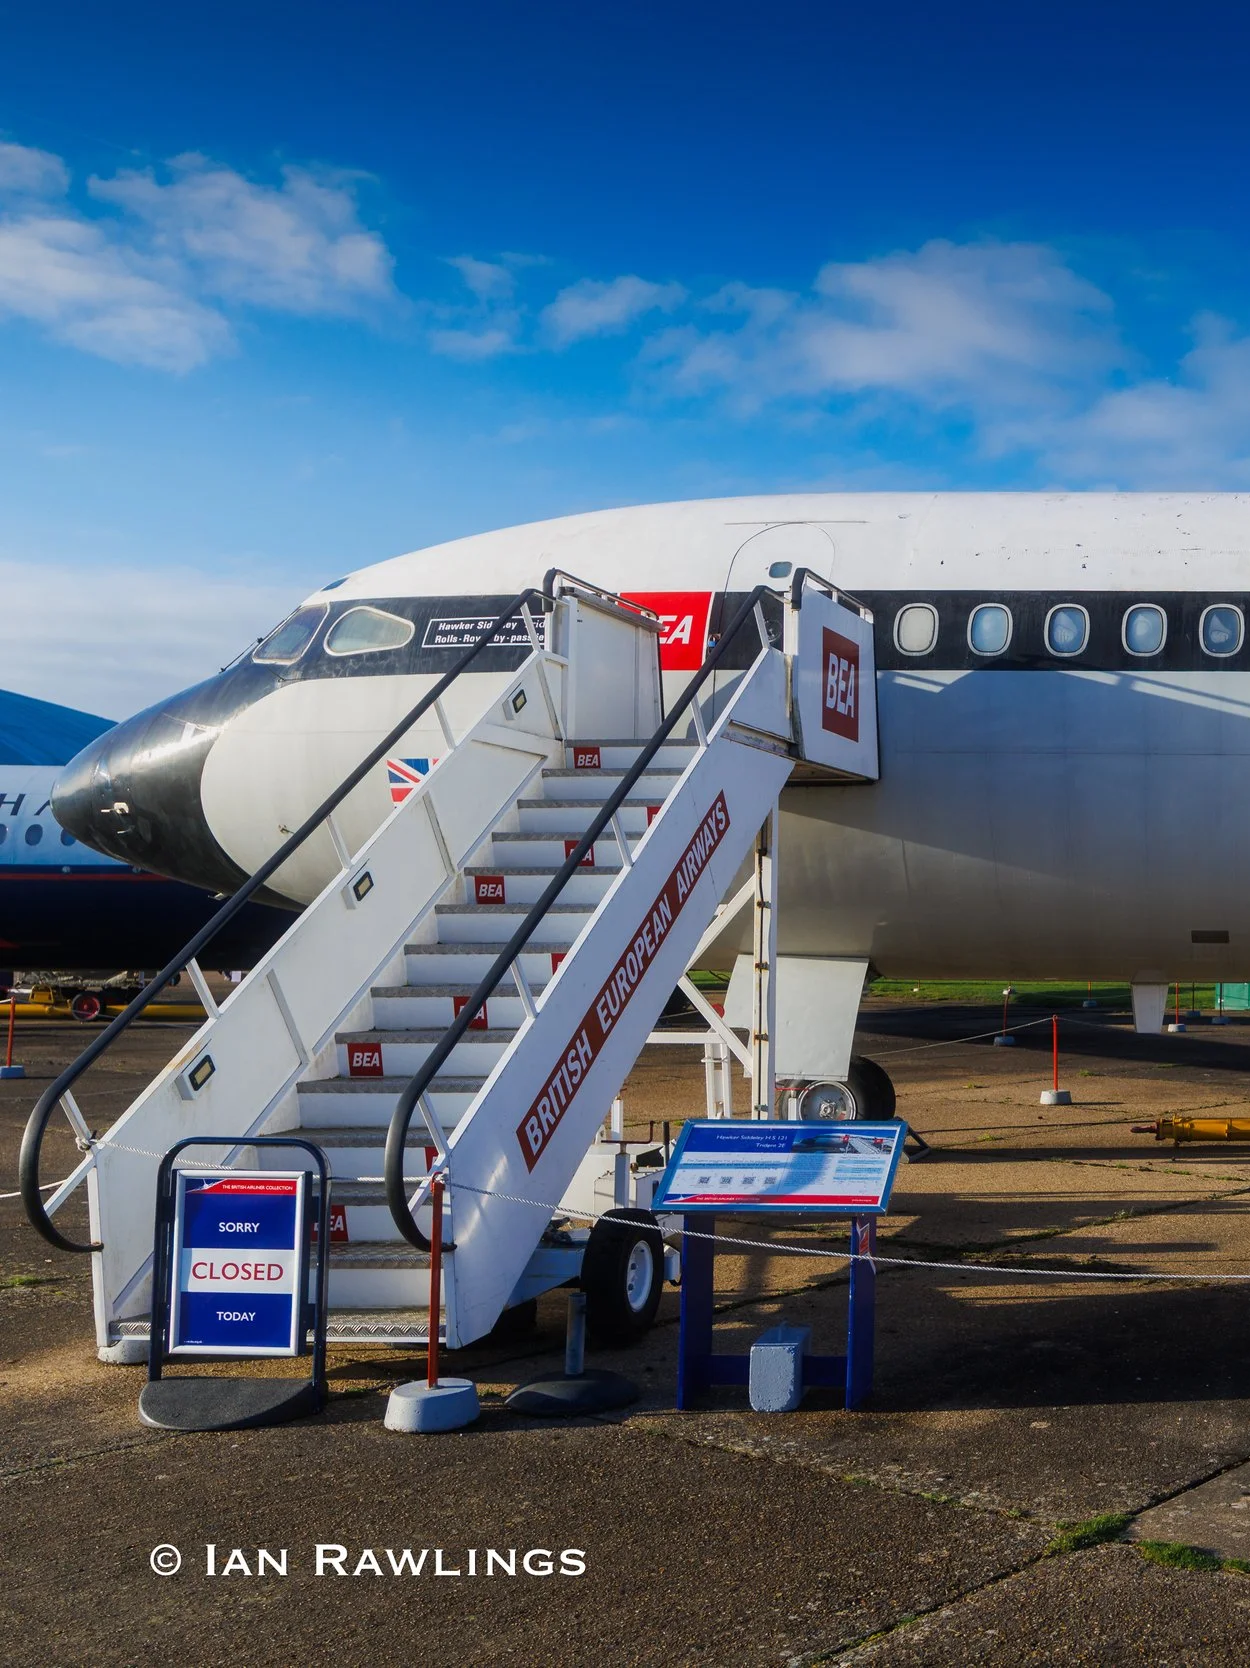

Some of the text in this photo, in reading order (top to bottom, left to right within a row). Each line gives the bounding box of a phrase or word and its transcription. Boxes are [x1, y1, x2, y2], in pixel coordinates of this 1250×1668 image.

[438, 622, 475, 631] Hawker
[477, 621, 518, 631] Sidey
[658, 615, 693, 644] EA
[826, 652, 855, 718] BEA
[577, 754, 599, 766] BEA
[478, 884, 503, 897] BEA
[525, 800, 726, 1157] BRITISH EUROPEAN AIRWAYS
[352, 1053, 380, 1067] BEA
[219, 1222, 260, 1233] SORRY
[192, 1262, 284, 1281] CLOSED
[216, 1311, 256, 1322] TODAY
